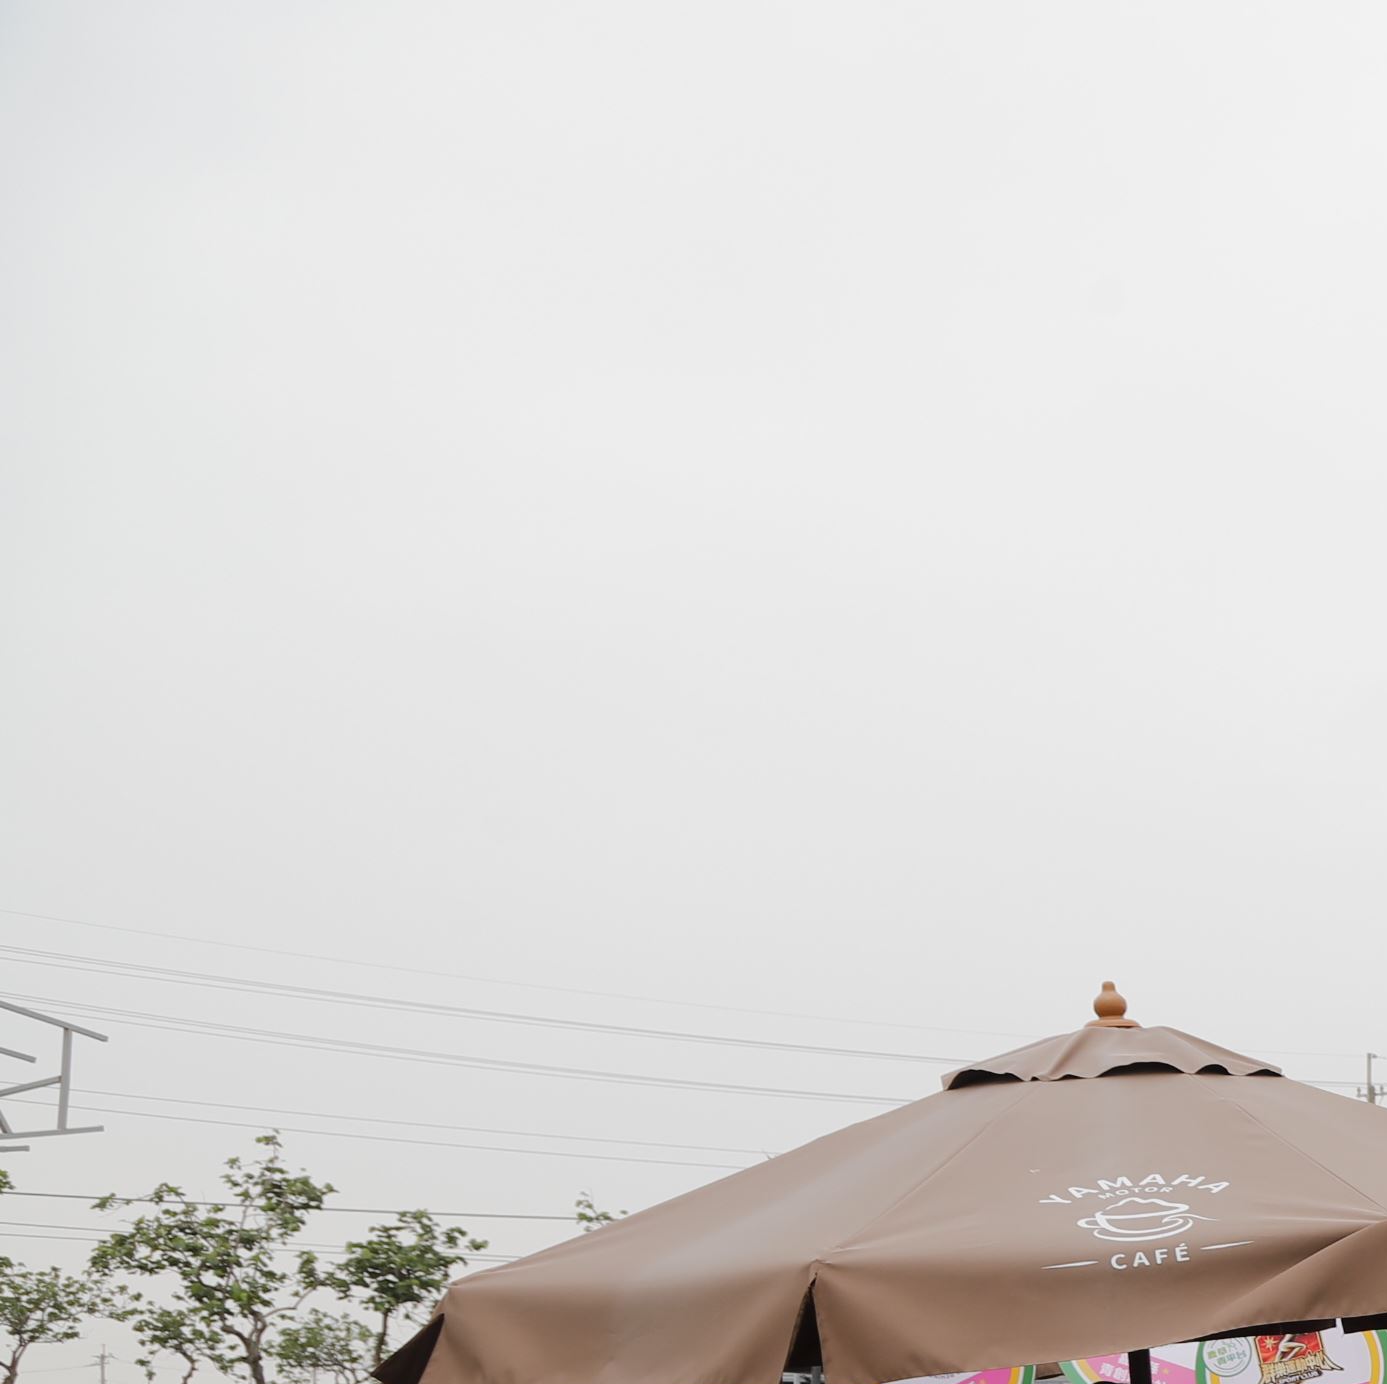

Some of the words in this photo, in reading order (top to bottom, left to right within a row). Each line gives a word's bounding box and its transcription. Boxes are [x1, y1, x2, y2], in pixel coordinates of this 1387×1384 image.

[1039, 1173, 1230, 1204] YAMAHA
[1098, 1186, 1173, 1200] MOTOR
[1110, 1243, 1191, 1270] CAFÉ
